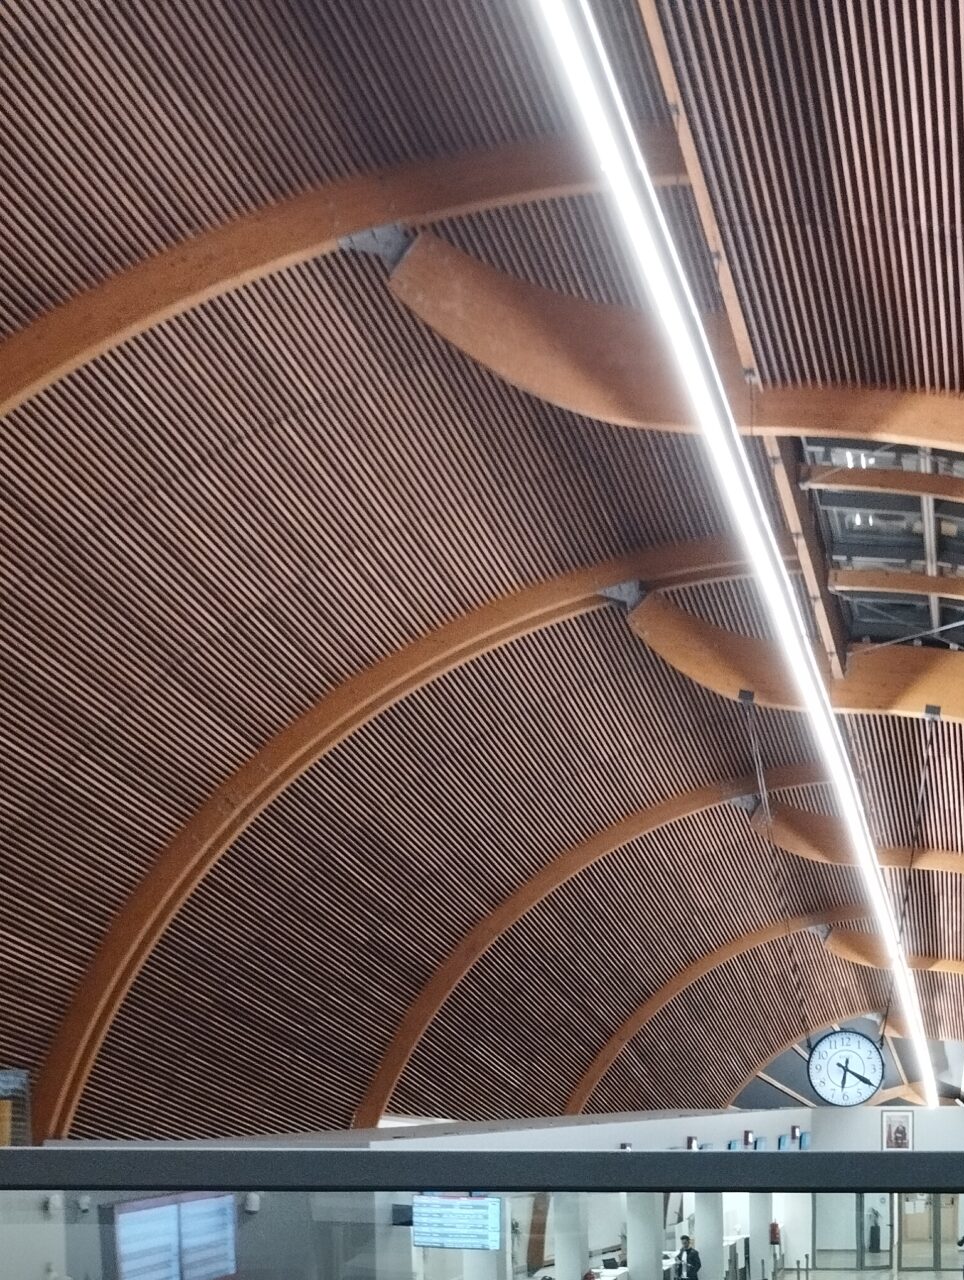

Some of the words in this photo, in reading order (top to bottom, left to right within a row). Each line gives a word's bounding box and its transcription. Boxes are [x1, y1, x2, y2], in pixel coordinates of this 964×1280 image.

[829, 1040, 837, 1049] 11
[840, 1037, 851, 1046] 12
[818, 1051, 828, 1060] 10
[867, 1050, 872, 1059] 2
[815, 1064, 822, 1073] 9
[871, 1064, 876, 1073] 3
[830, 1089, 835, 1098] 7
[842, 1092, 849, 1100] 6
